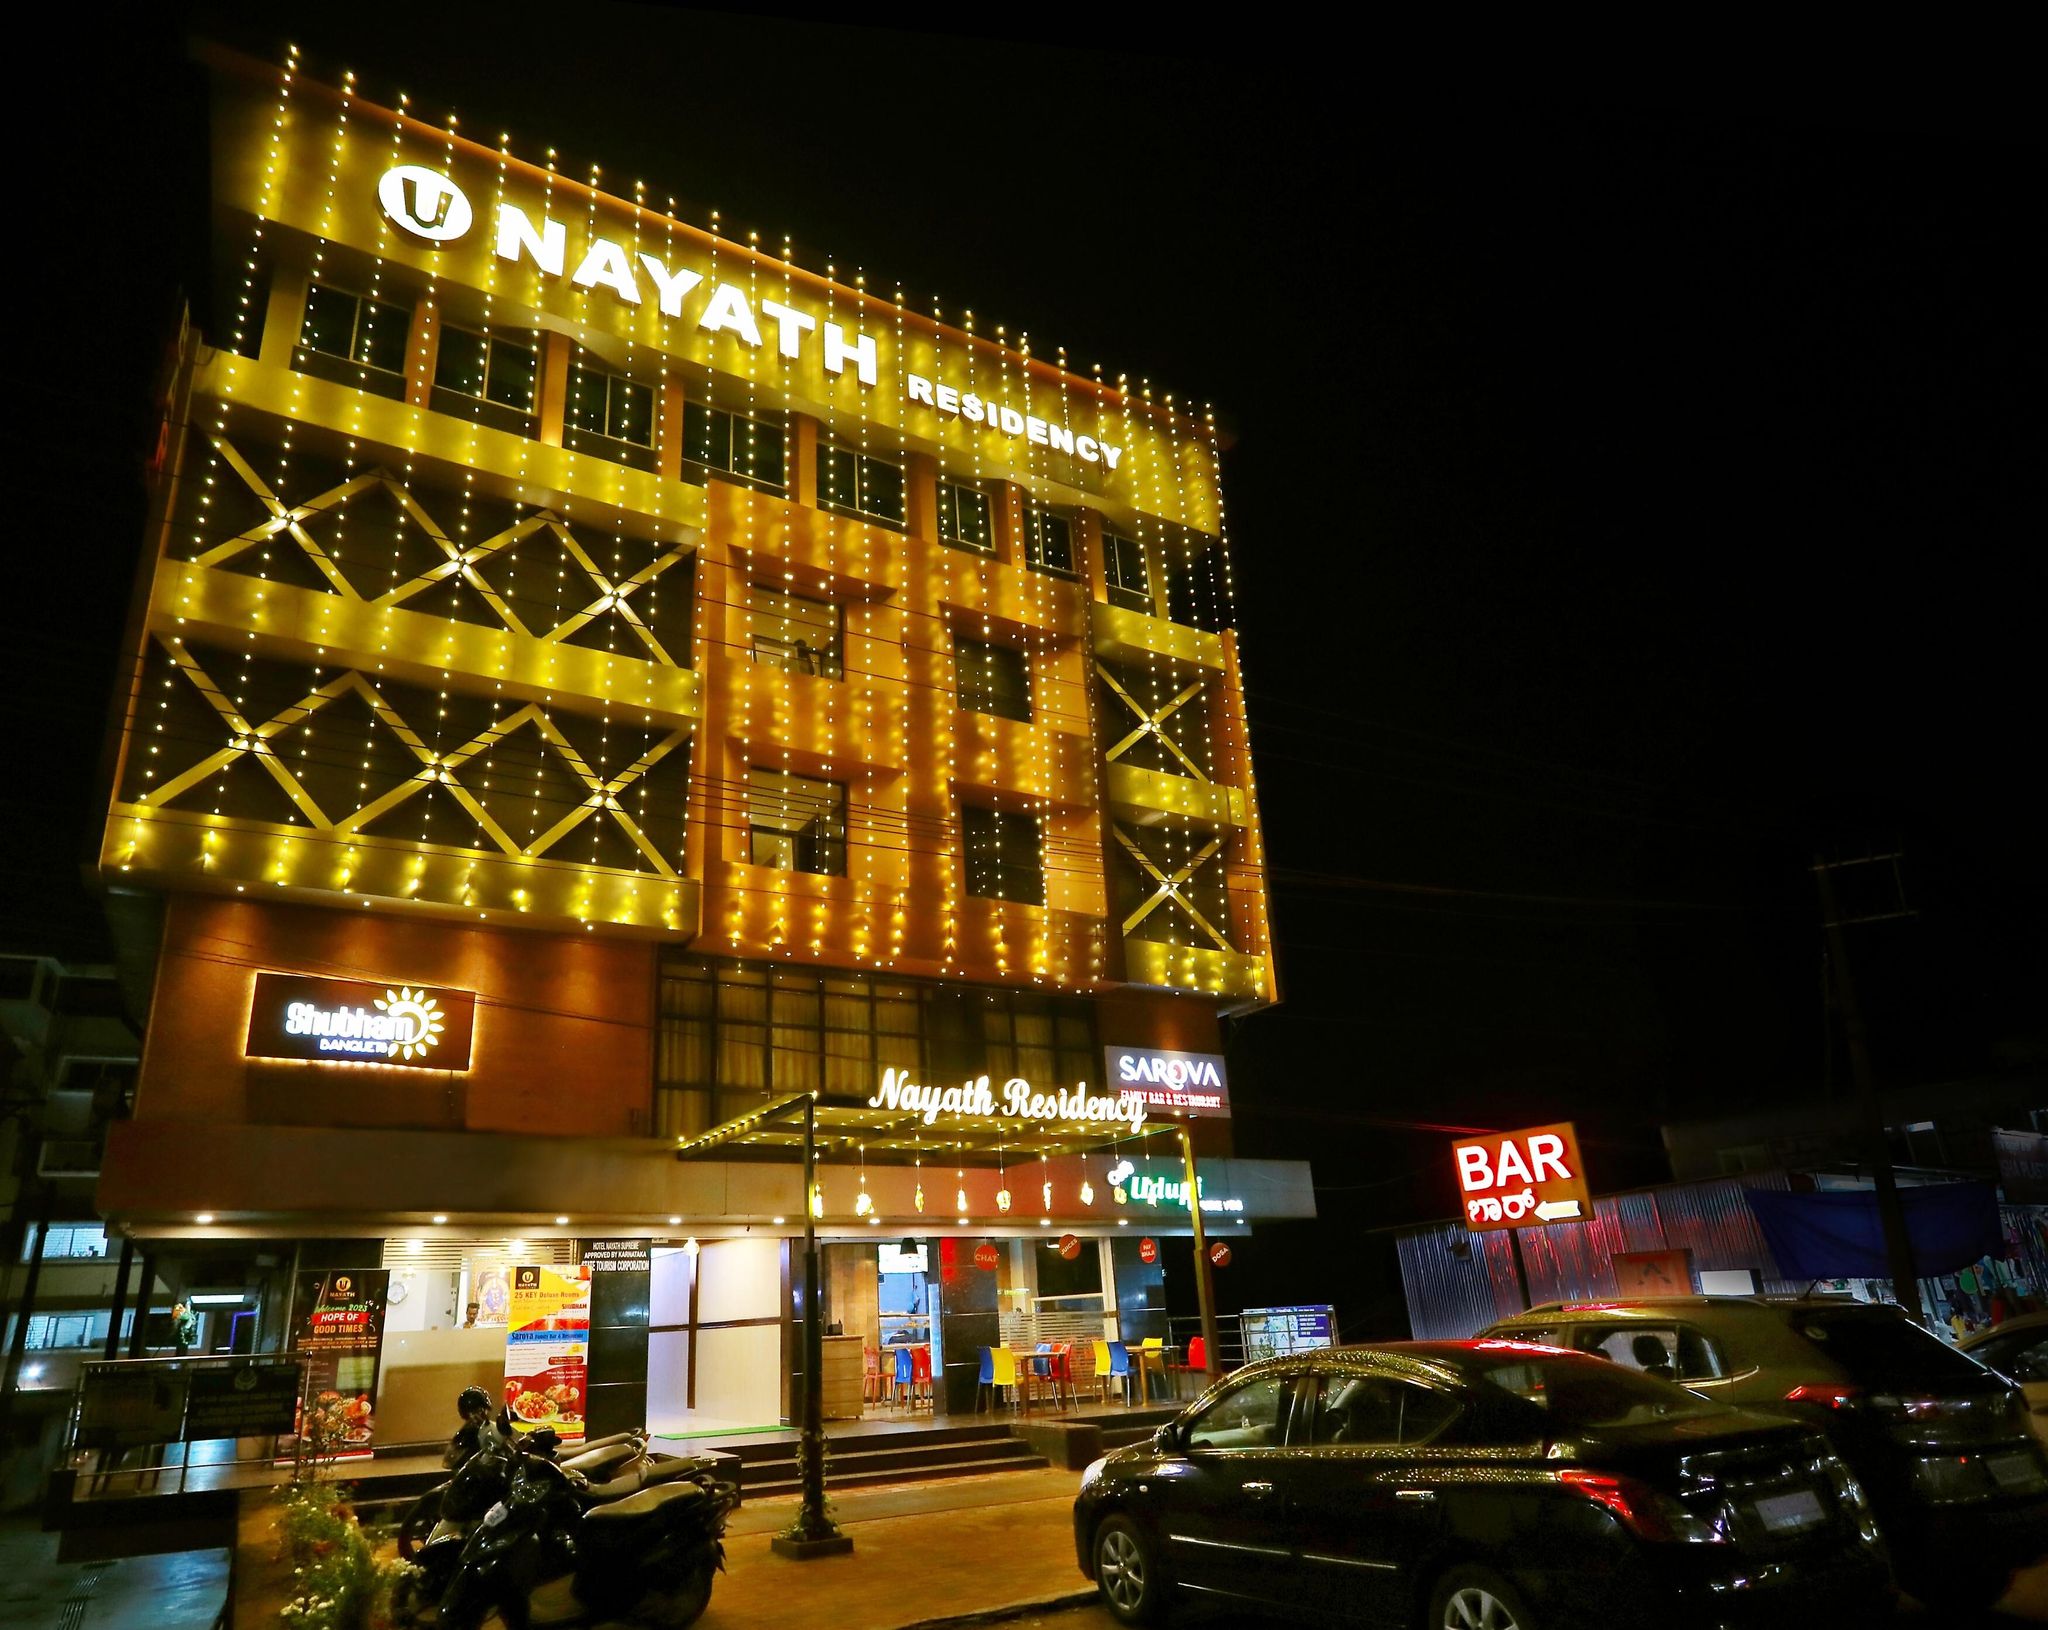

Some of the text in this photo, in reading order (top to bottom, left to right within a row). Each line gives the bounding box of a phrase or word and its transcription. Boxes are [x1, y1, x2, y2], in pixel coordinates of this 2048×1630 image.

[496, 202, 1122, 470] NAYATH RESIDENCY
[286, 1003, 414, 1041] Shubham
[1119, 1055, 1222, 1091] SAROVA
[869, 1067, 1148, 1134] Nayath Residency
[1148, 1091, 1166, 1105] BAR
[1166, 1093, 1173, 1105] &
[1173, 1094, 1221, 1109] RESTAURANT
[1456, 1133, 1572, 1192] BAR
[592, 1241, 639, 1250] HOTEL NAYATH SUPREME
[1061, 1238, 1078, 1255] JUICES
[584, 1251, 611, 1259] APPROVED
[618, 1250, 646, 1258] KARNATAKA
[975, 1253, 997, 1263] CHAT
[1211, 1247, 1229, 1263] DOSA
[596, 1260, 617, 1271] TOURISM
[617, 1260, 650, 1271] CORPORATION
[514, 1291, 523, 1299] 25
[525, 1291, 538, 1299] KEY
[348, 1304, 368, 1312] 2023
[321, 1313, 359, 1322] HOPE OF
[314, 1324, 363, 1333] GOOD TIMES
